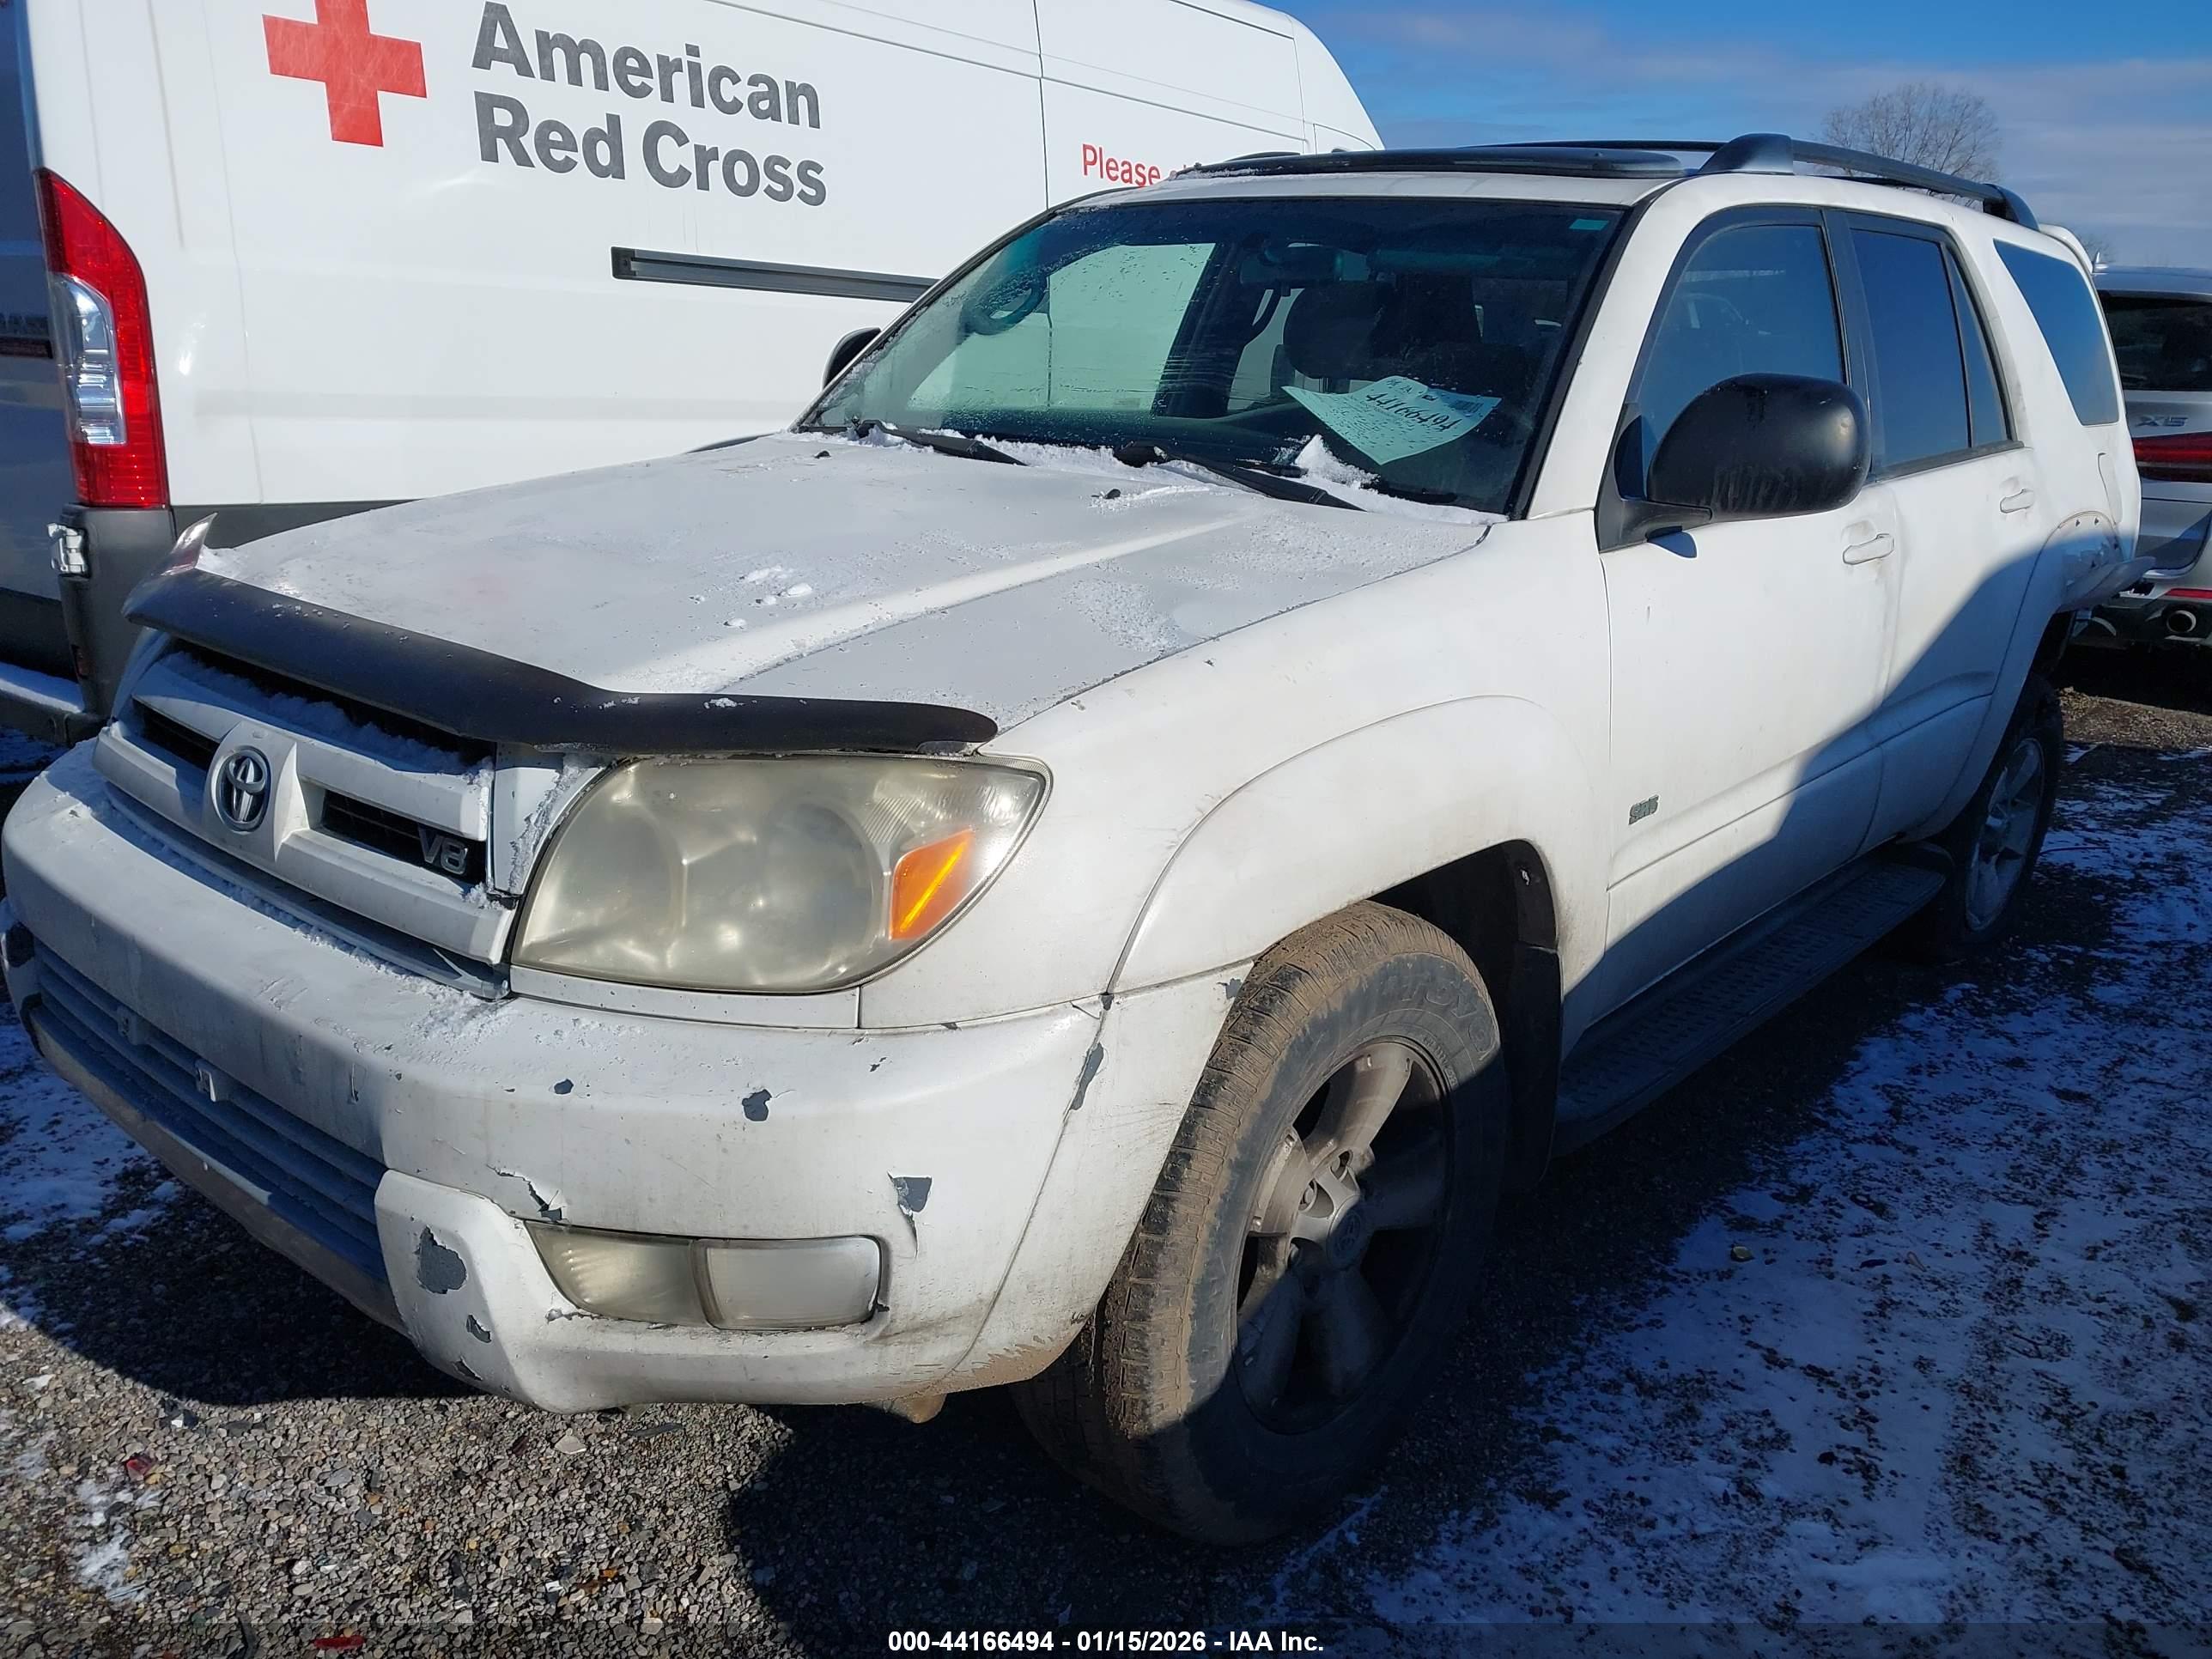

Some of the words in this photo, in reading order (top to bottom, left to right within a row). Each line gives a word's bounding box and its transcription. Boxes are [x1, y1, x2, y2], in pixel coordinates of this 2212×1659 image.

[471, 1, 821, 130] American
[474, 90, 626, 180] Red
[642, 119, 827, 207] Cross
[1082, 143, 1161, 186] Please
[1365, 392, 1463, 431] 44166494
[2136, 414, 2189, 427] X5
